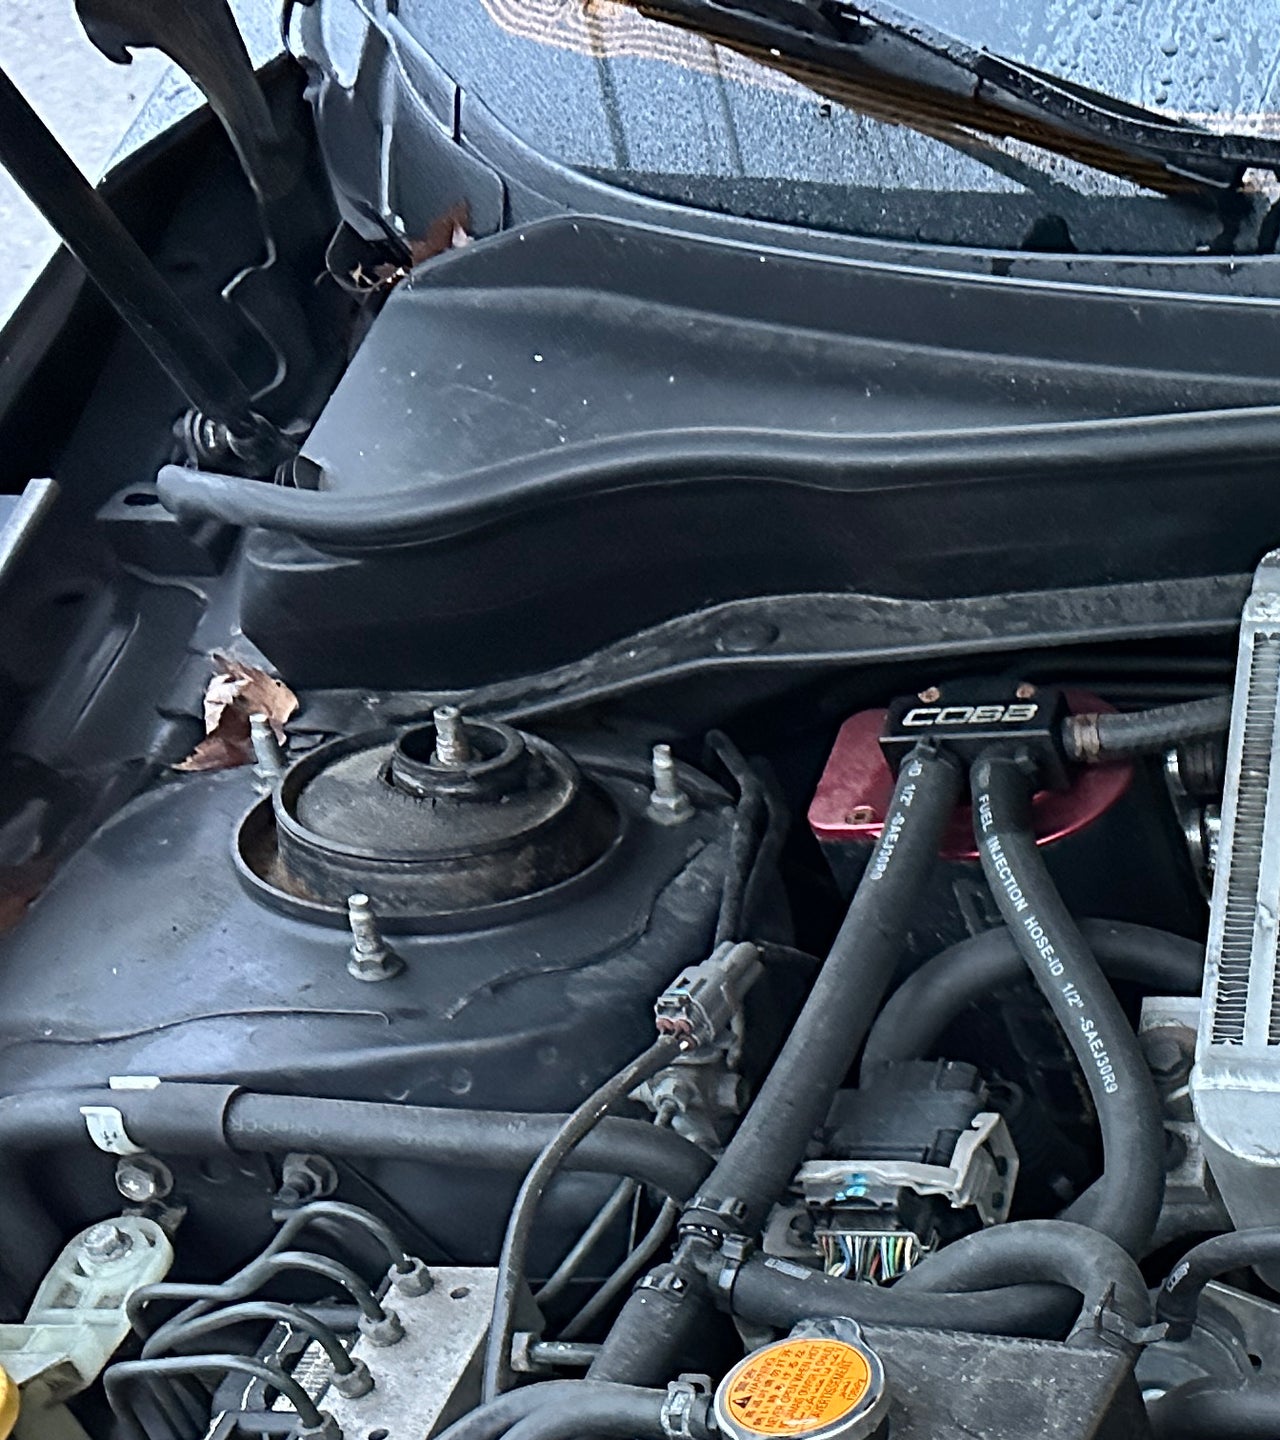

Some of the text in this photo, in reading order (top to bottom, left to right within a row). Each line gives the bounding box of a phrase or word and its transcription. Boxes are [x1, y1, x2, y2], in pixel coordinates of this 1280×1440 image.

[902, 704, 1038, 726] COBB
[978, 793, 993, 833] FUEL
[986, 836, 1027, 913] INJECTION
[1023, 916, 1065, 977] HOSE-ID
